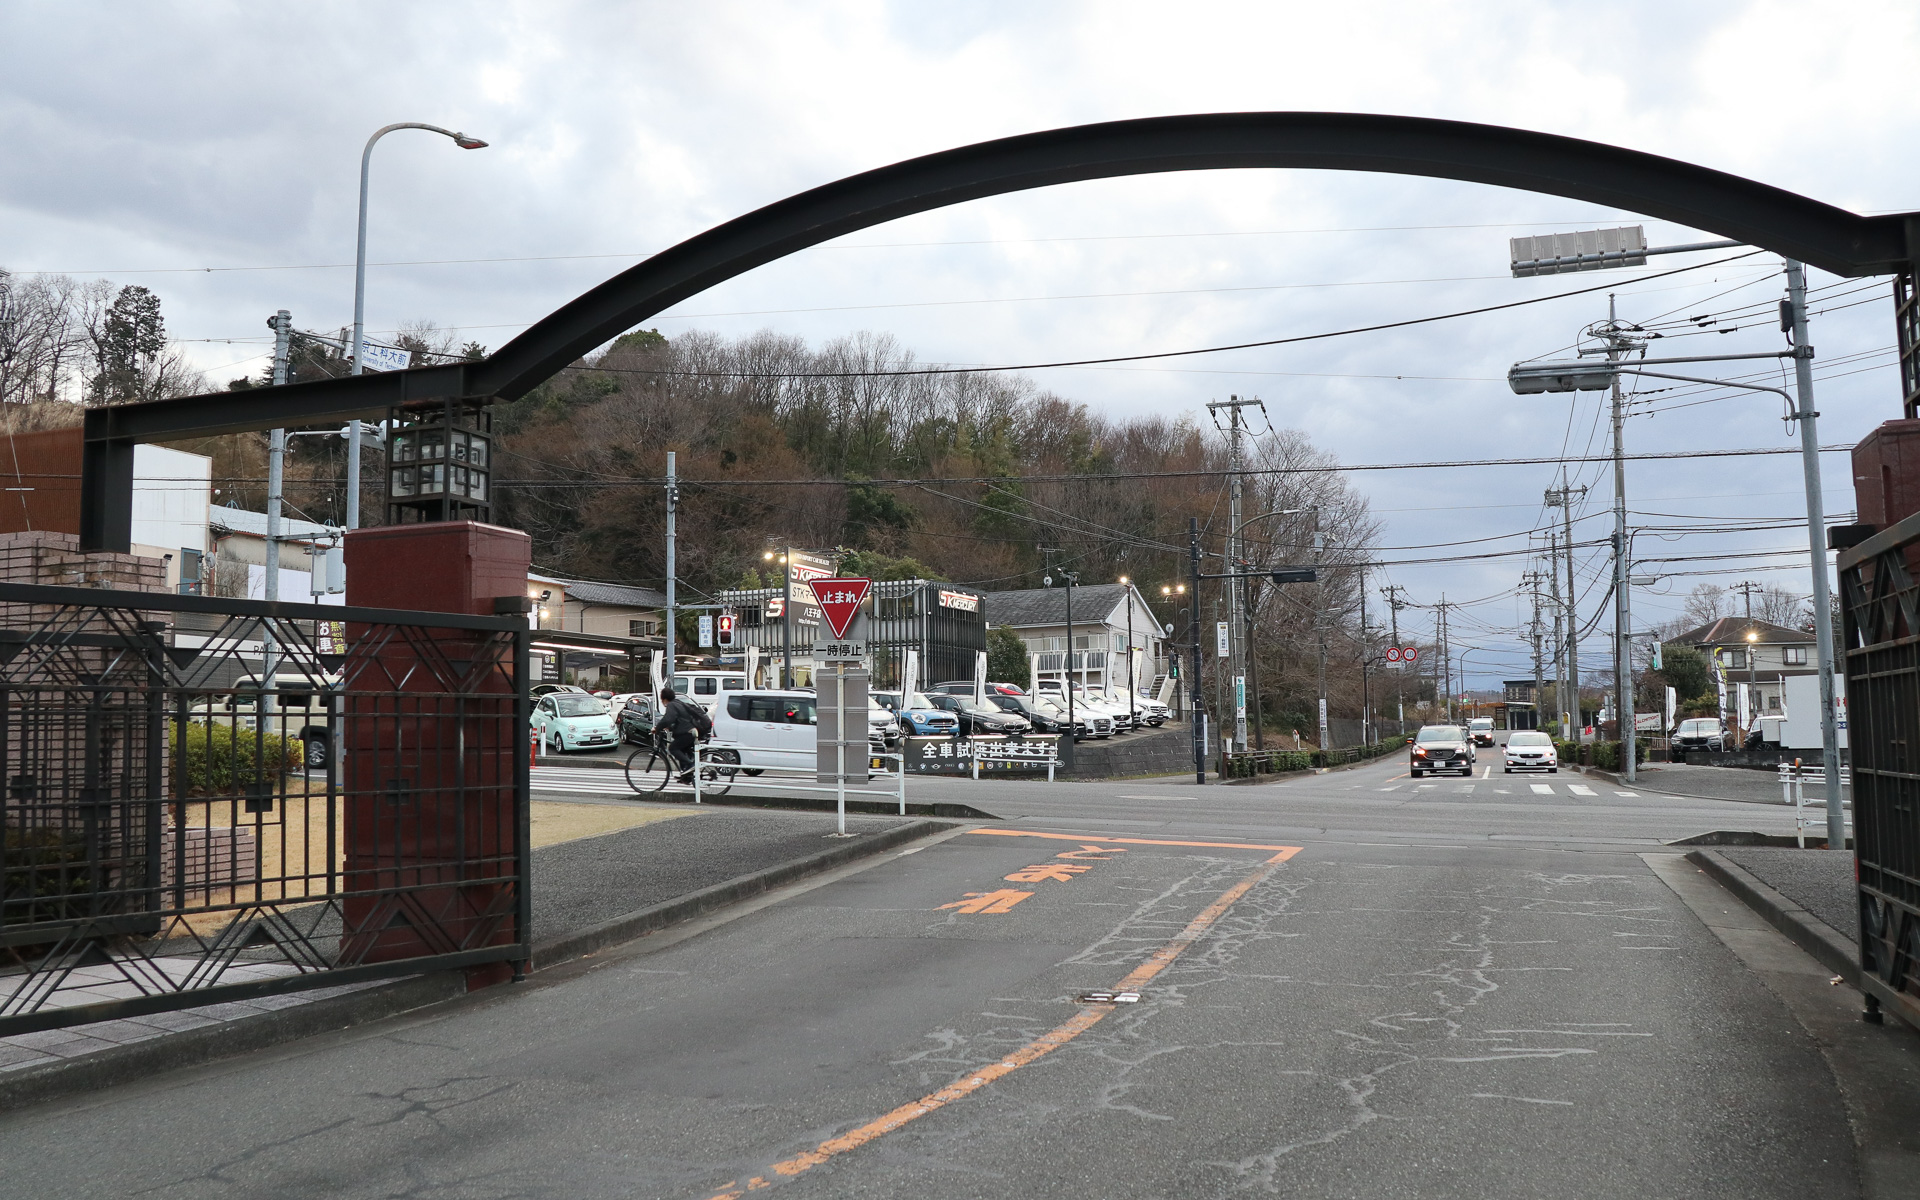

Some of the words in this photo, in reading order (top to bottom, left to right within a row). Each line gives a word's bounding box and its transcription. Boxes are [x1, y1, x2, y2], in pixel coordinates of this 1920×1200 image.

[822, 590, 857, 604] 止まれ
[815, 644, 862, 657] 一時停止
